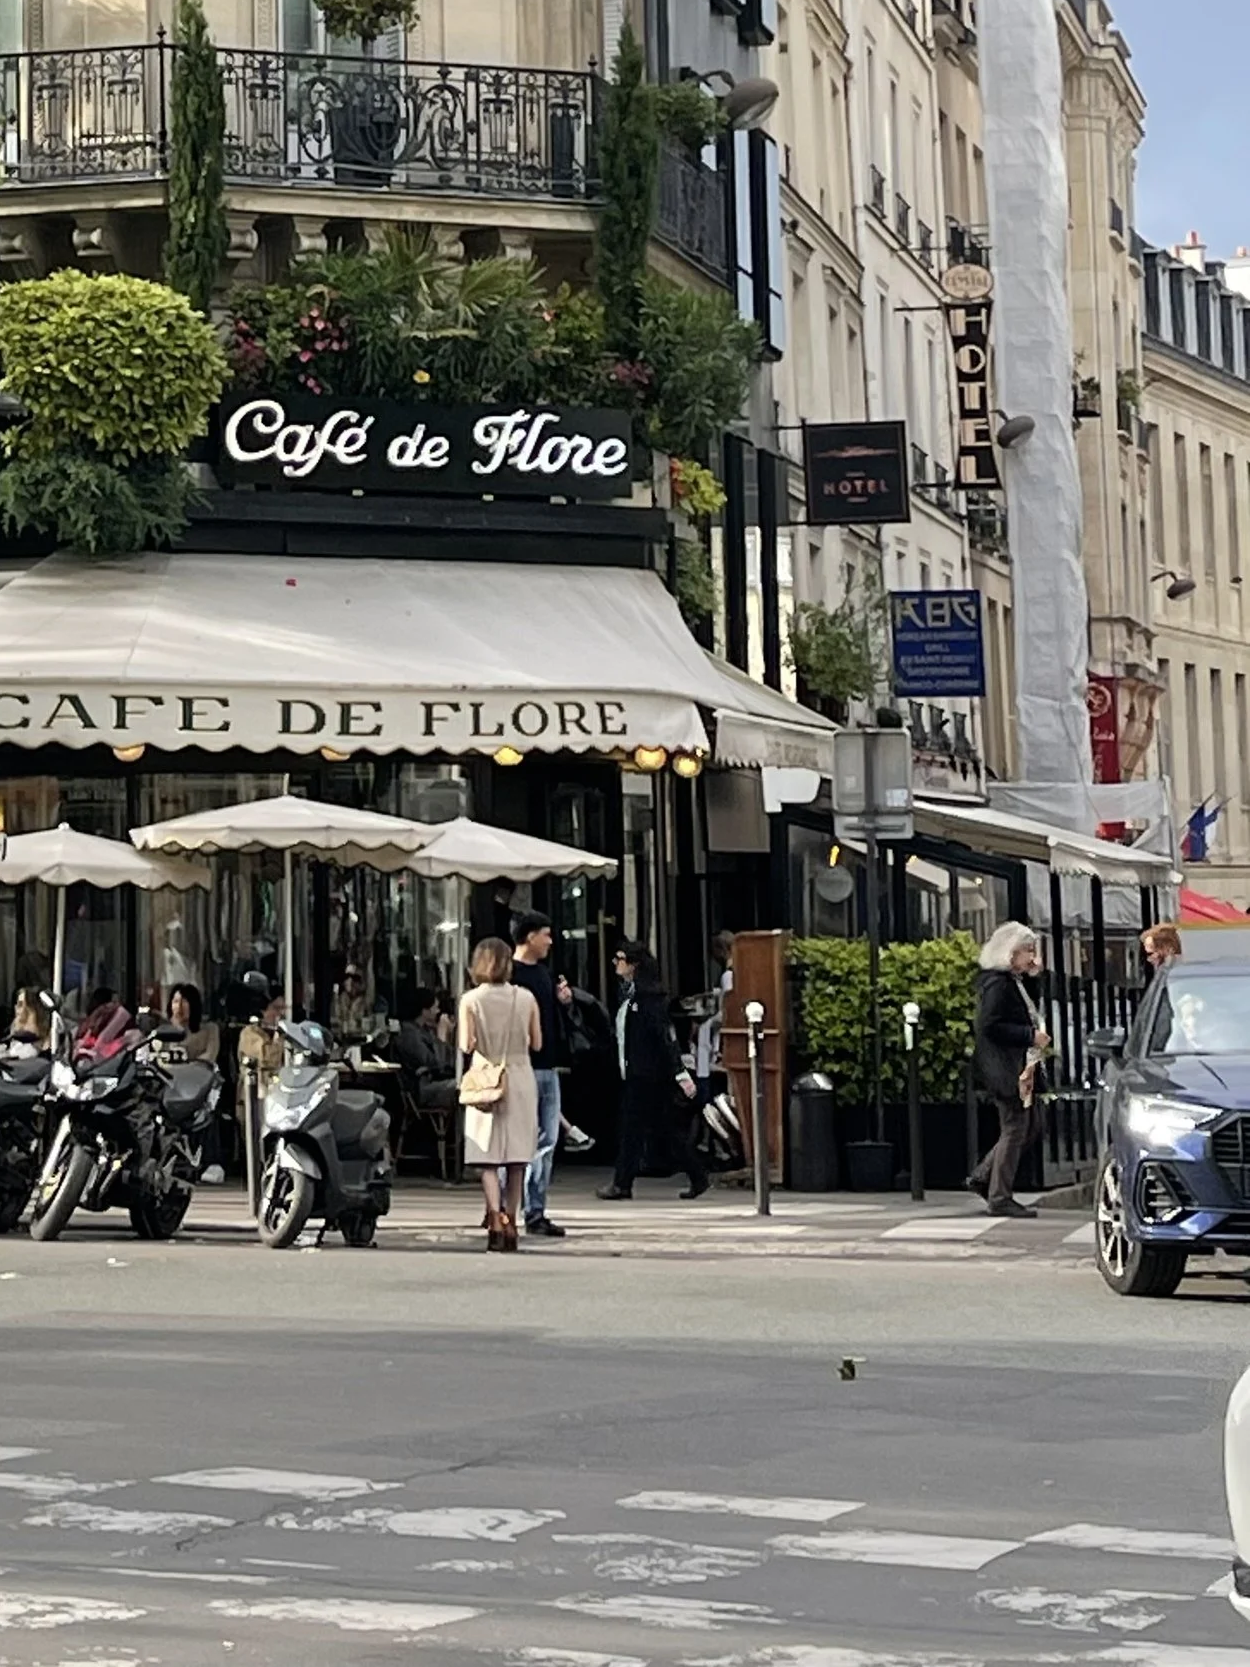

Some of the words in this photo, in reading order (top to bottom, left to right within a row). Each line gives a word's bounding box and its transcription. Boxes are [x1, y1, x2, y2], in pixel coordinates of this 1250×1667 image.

[949, 307, 998, 484] HOTEL
[225, 399, 375, 478] Café
[386, 424, 450, 469] de
[471, 409, 629, 476] Flore
[822, 478, 890, 495] HOTEL
[277, 699, 384, 737] DE
[419, 701, 629, 737] FLORE
